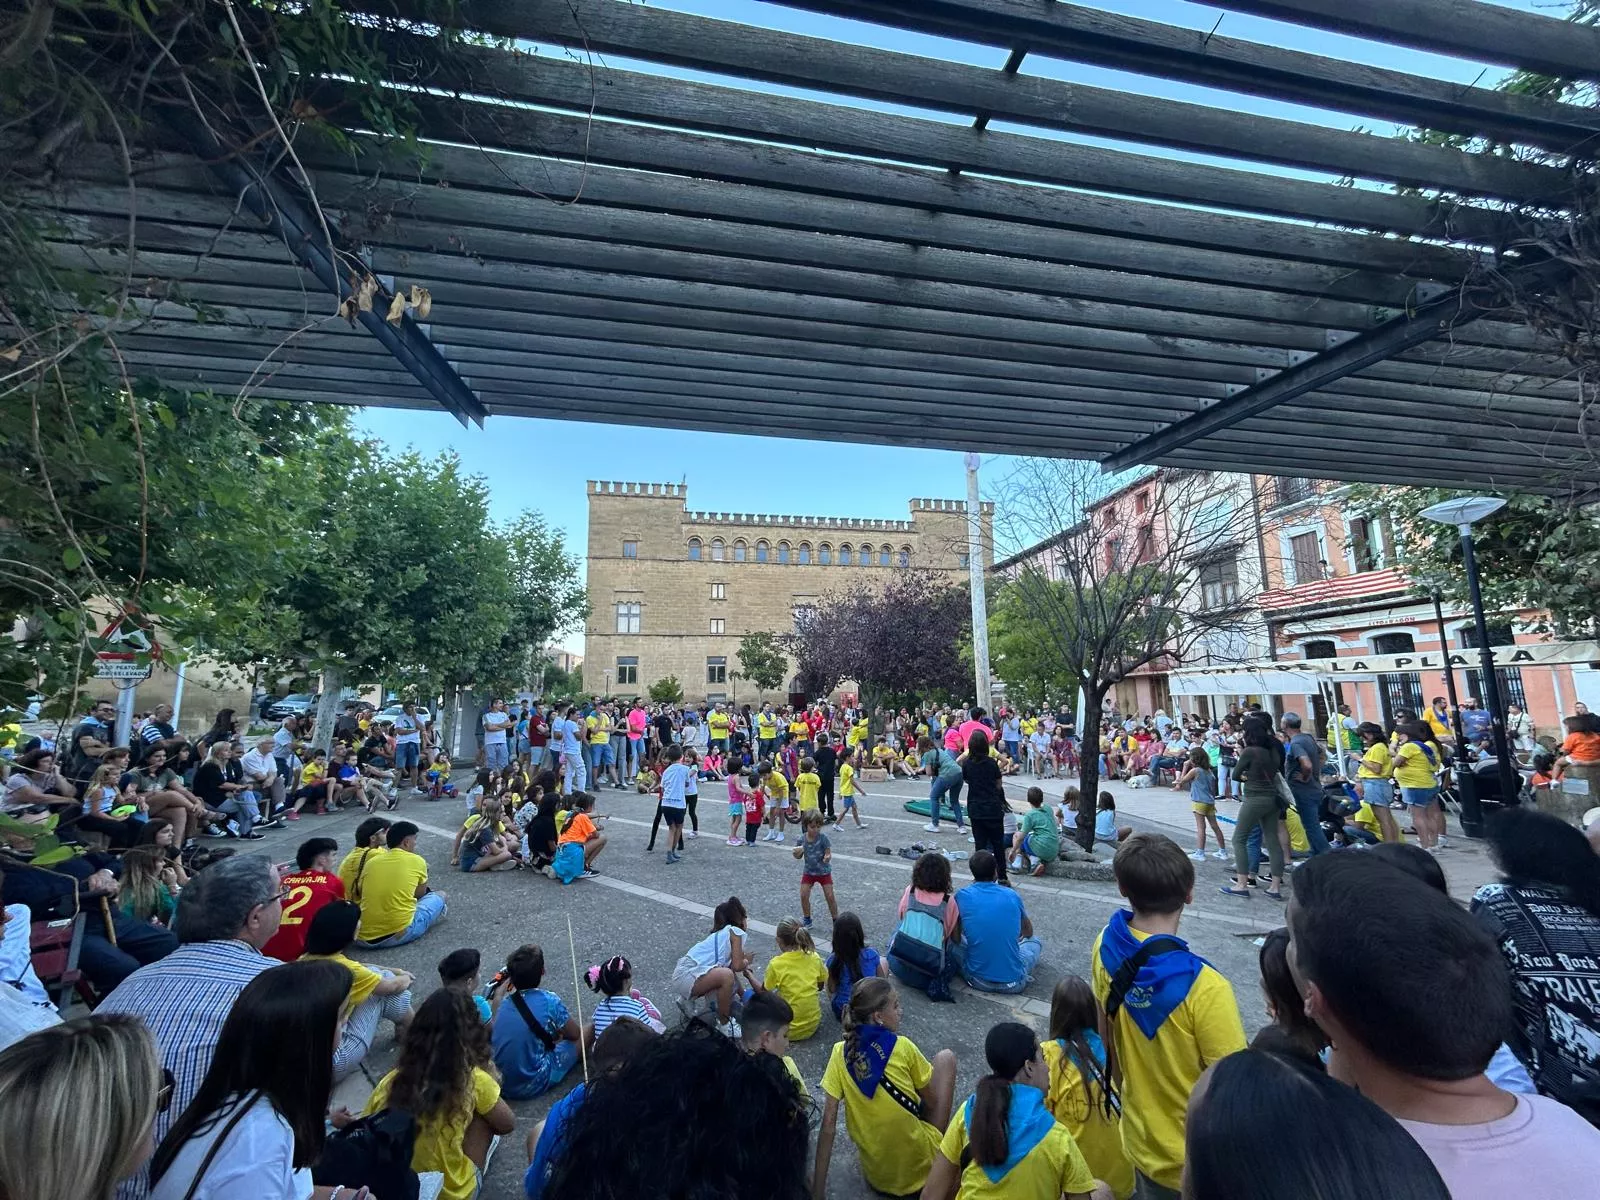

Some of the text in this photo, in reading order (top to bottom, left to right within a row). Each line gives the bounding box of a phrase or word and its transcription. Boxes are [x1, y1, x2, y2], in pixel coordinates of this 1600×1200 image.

[1276, 663, 1313, 672] DE
[1331, 661, 1369, 672] LA
[1394, 649, 1536, 669] PLAA
[283, 875, 327, 884] CARVAJAL
[280, 885, 313, 925] 2
[1519, 952, 1599, 971] New York
